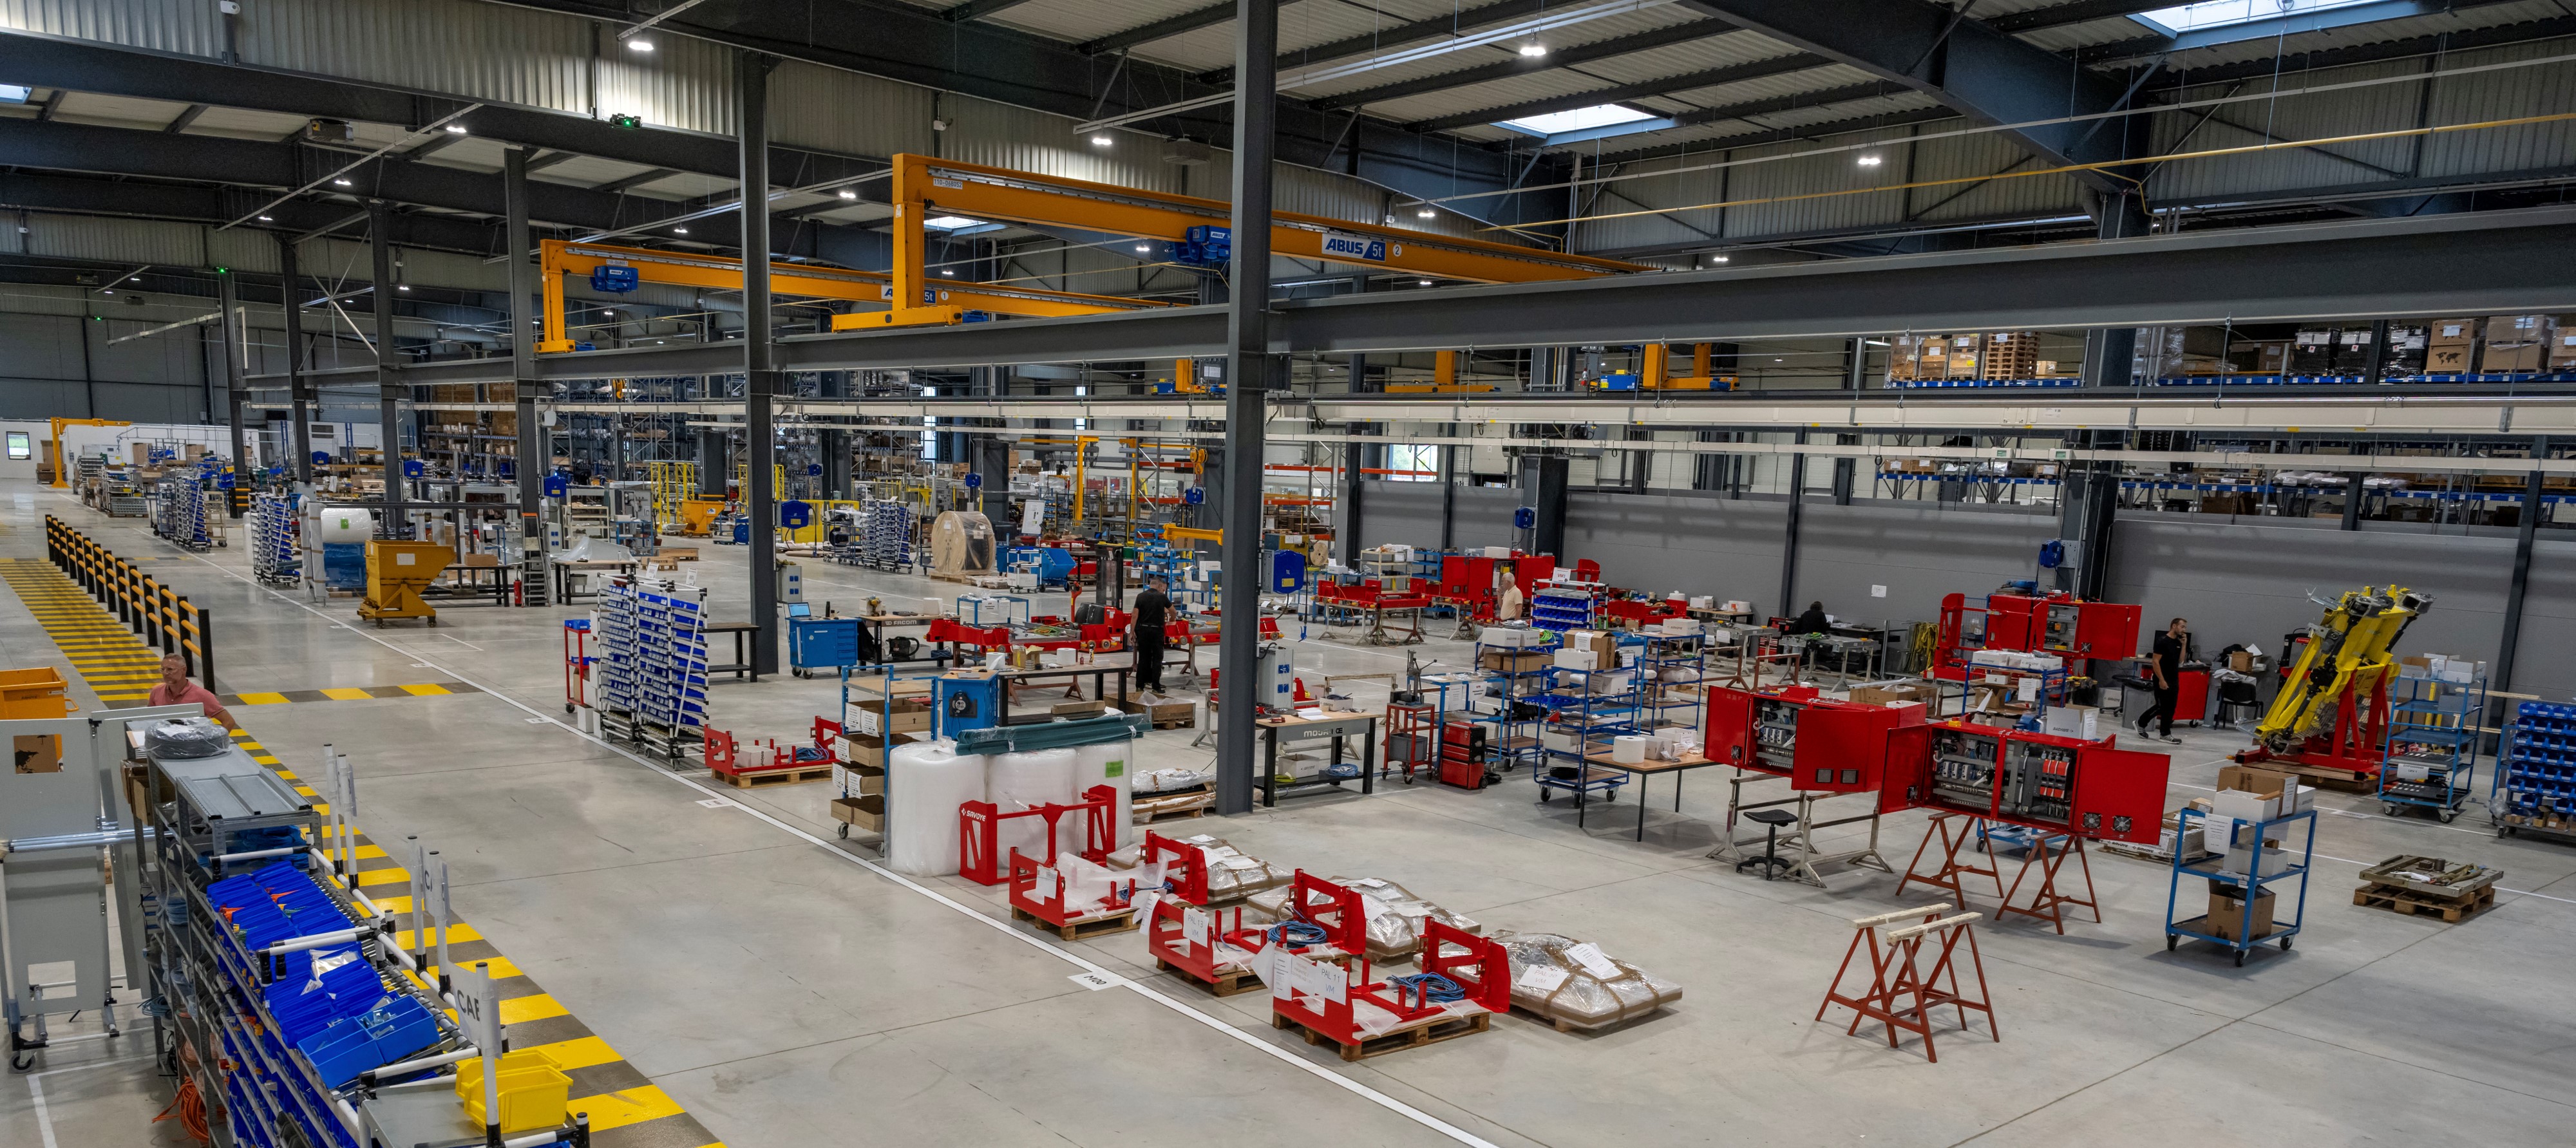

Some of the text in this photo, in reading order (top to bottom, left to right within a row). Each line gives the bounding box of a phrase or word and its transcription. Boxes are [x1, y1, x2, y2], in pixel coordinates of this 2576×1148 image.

[934, 178, 962, 189] 110-068052
[1325, 239, 1400, 258] ABUS 5t 2
[924, 292, 933, 301] 5t
[967, 811, 986, 822] SAVOYE
[1188, 914, 1204, 928] PAL 13
[1191, 928, 1198, 937] VM
[1321, 968, 1331, 980] PAL
[1334, 974, 1340, 983] 11
[1325, 984, 1334, 995] VM
